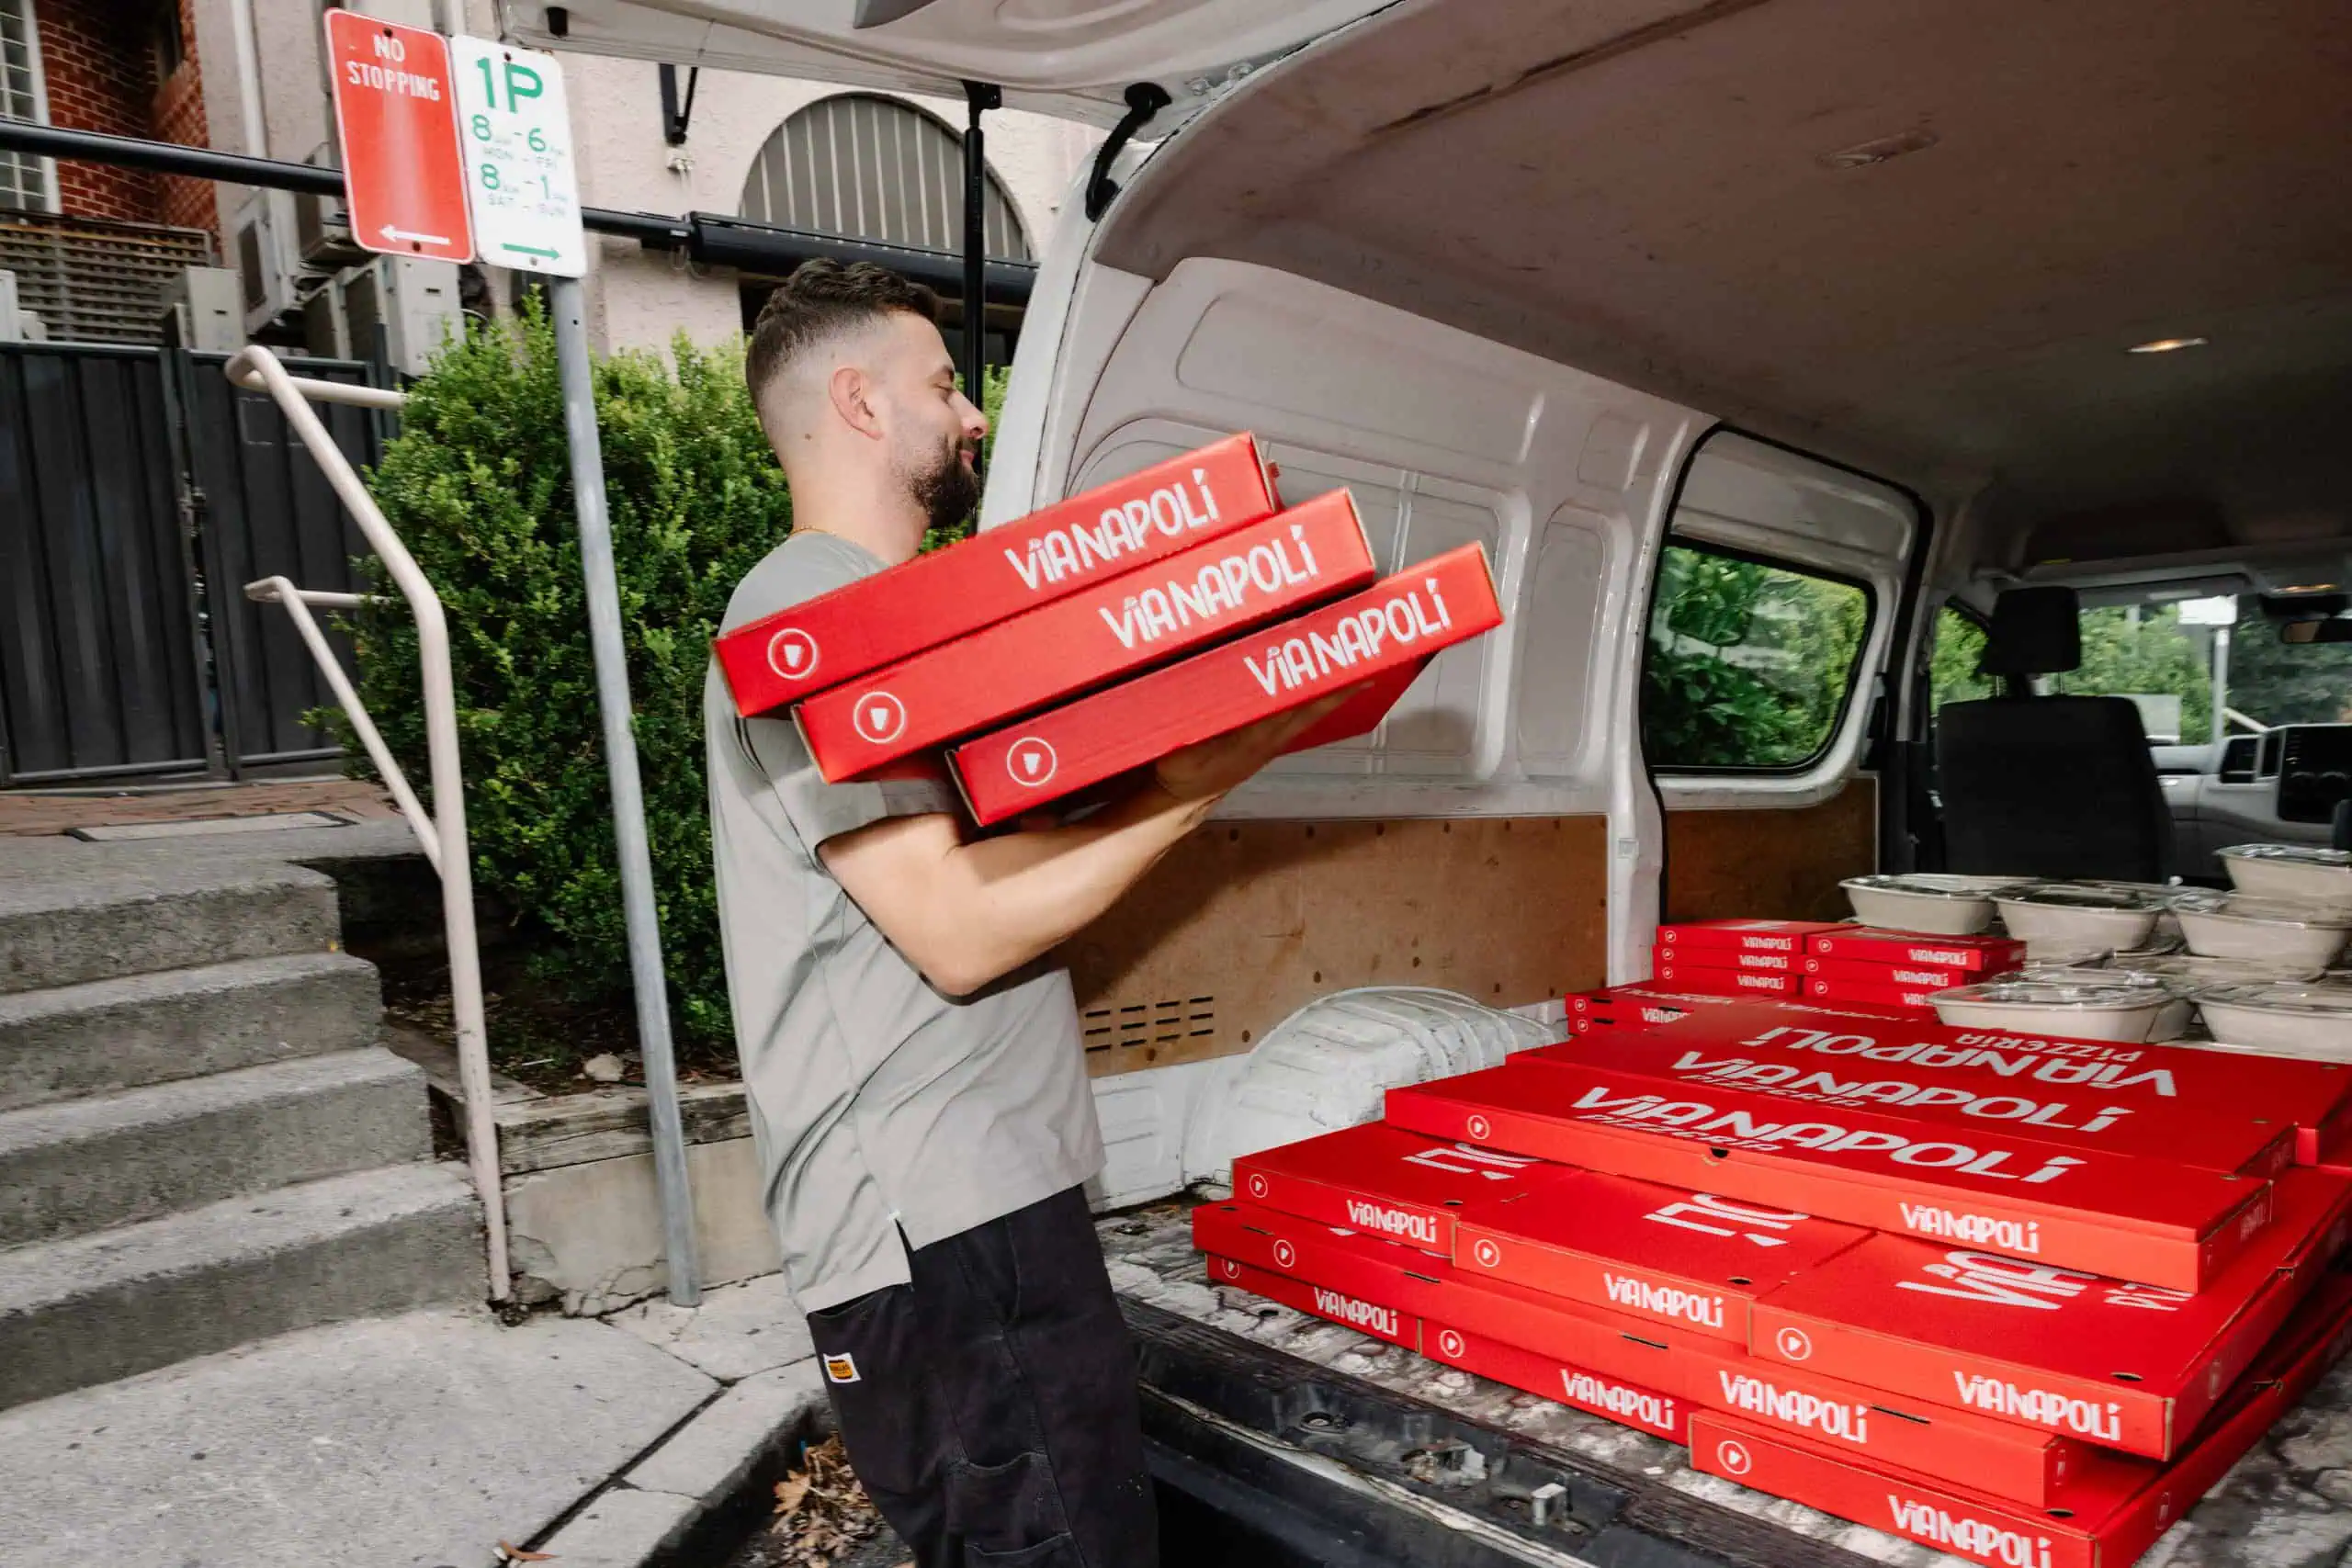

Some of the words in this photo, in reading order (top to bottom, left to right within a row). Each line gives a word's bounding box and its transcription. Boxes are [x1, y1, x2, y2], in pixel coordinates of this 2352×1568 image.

[373, 35, 405, 62] NO
[345, 61, 441, 102] STOPPING
[476, 57, 544, 114] 1P
[471, 114, 492, 142] 8
[528, 128, 547, 152] 6
[481, 164, 501, 190] 8
